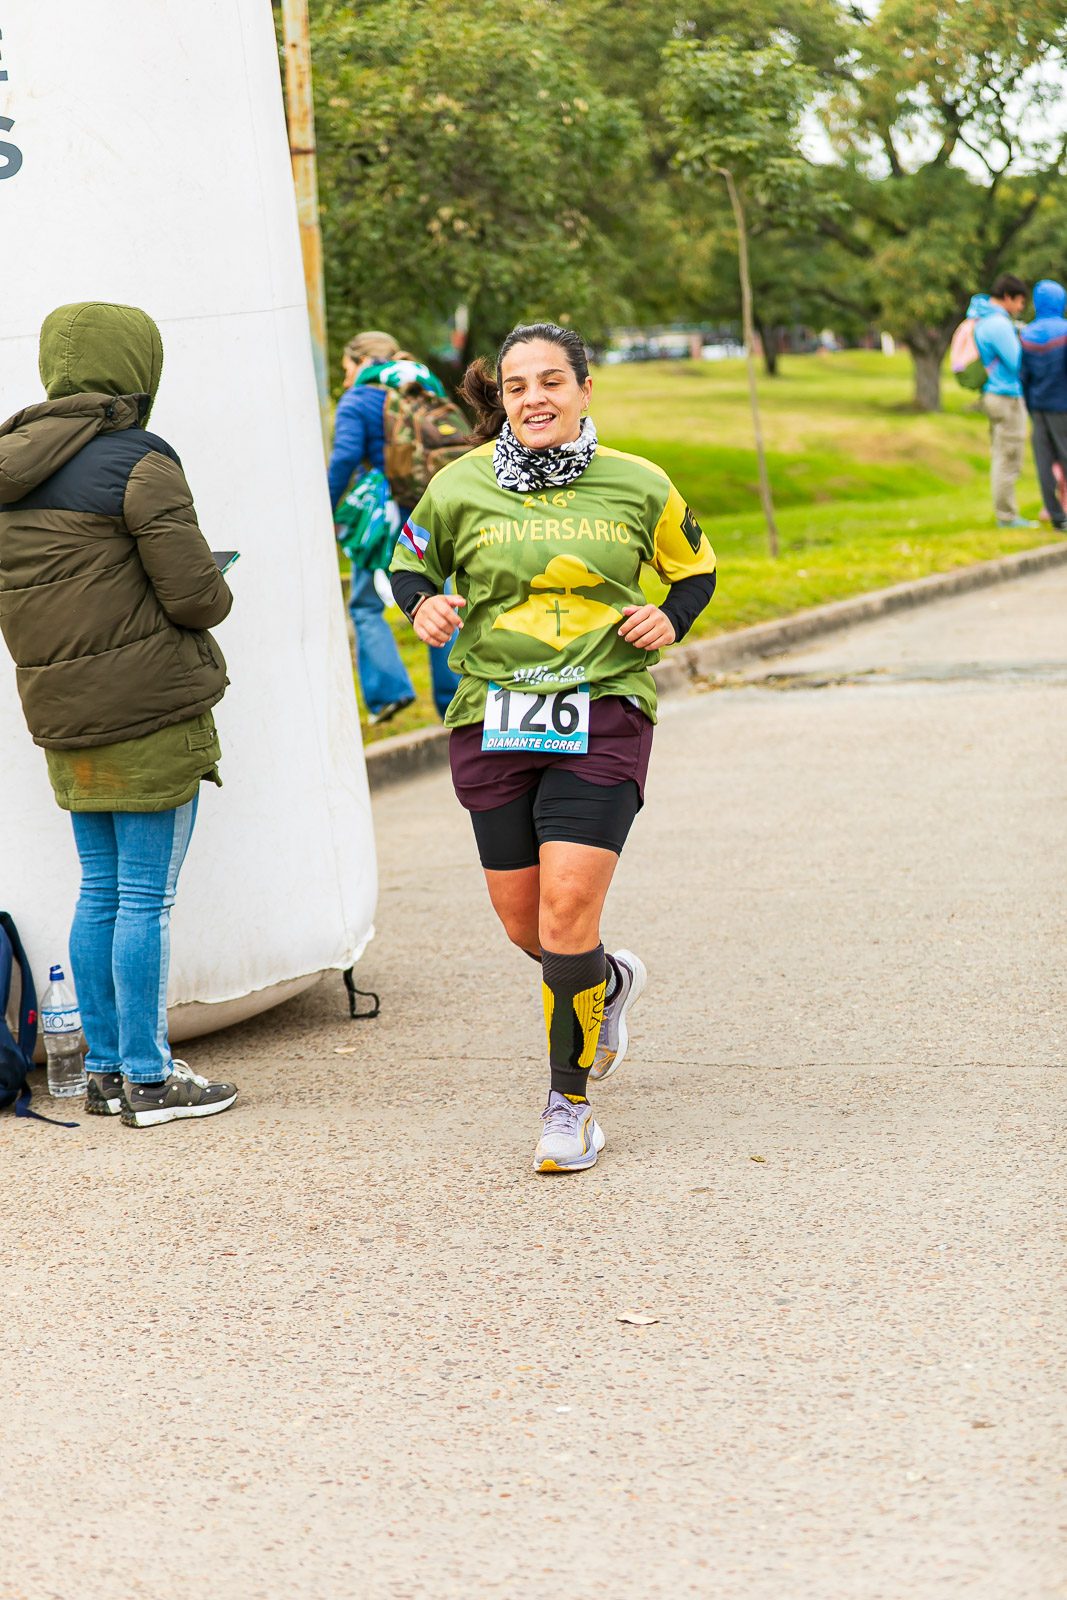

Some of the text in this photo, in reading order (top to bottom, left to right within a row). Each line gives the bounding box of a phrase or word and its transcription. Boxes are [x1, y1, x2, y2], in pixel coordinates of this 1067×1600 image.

[476, 518, 631, 549] ANIVERSARIO
[494, 684, 580, 735] 126
[486, 737, 582, 751] DIAMANTE CORRE
